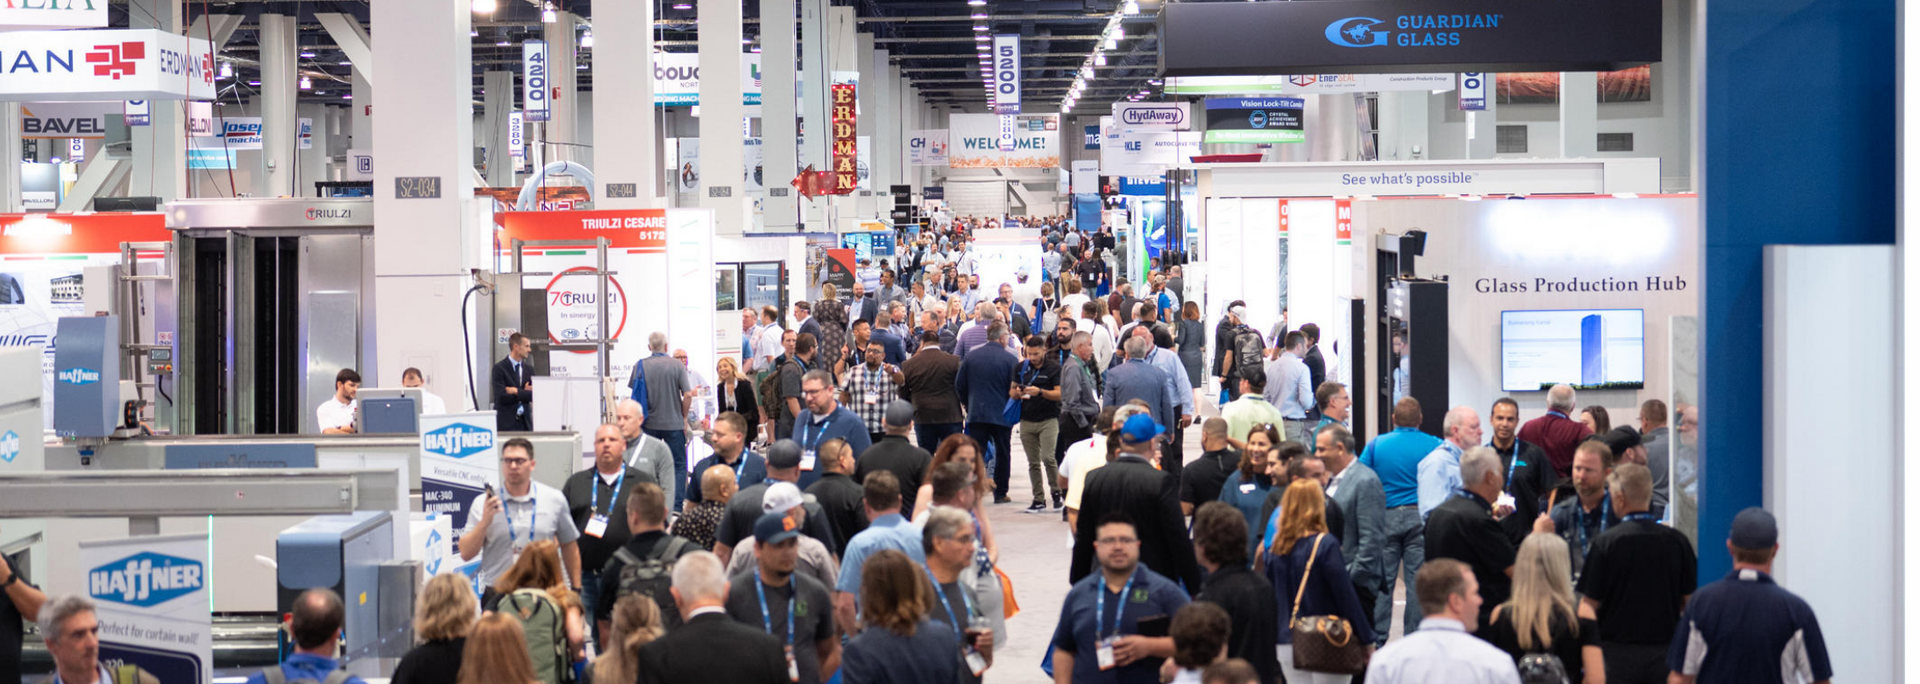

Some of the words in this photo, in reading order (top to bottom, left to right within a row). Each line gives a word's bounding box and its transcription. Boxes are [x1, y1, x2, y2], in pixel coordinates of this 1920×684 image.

[1397, 14, 1498, 29] GUARDIAN
[1397, 32, 1460, 47] GLASS
[0, 50, 73, 73] AN
[160, 48, 201, 78] ERDMAN
[529, 52, 544, 101] 4200
[999, 45, 1016, 95] 5200
[1129, 110, 1177, 125] HydAway
[836, 88, 855, 190] ERDMAN
[963, 137, 1046, 149] WELCME!
[1342, 173, 1366, 186] See
[1416, 171, 1472, 187] possible
[401, 178, 435, 197] S2-034
[609, 184, 633, 197] S2-044
[306, 207, 351, 220] TRIULZI
[582, 218, 621, 229] TRIULZI
[624, 216, 665, 228] CESARE
[639, 231, 665, 240] 5172
[1475, 277, 1527, 293] Glass
[1534, 277, 1639, 293] Production
[1645, 276, 1688, 292] Hub
[425, 490, 453, 501] MAC-340
[425, 502, 461, 514] ALUMINUM
[97, 619, 129, 633] Perfect
[130, 623, 144, 637] for
[145, 628, 176, 641] curtain
